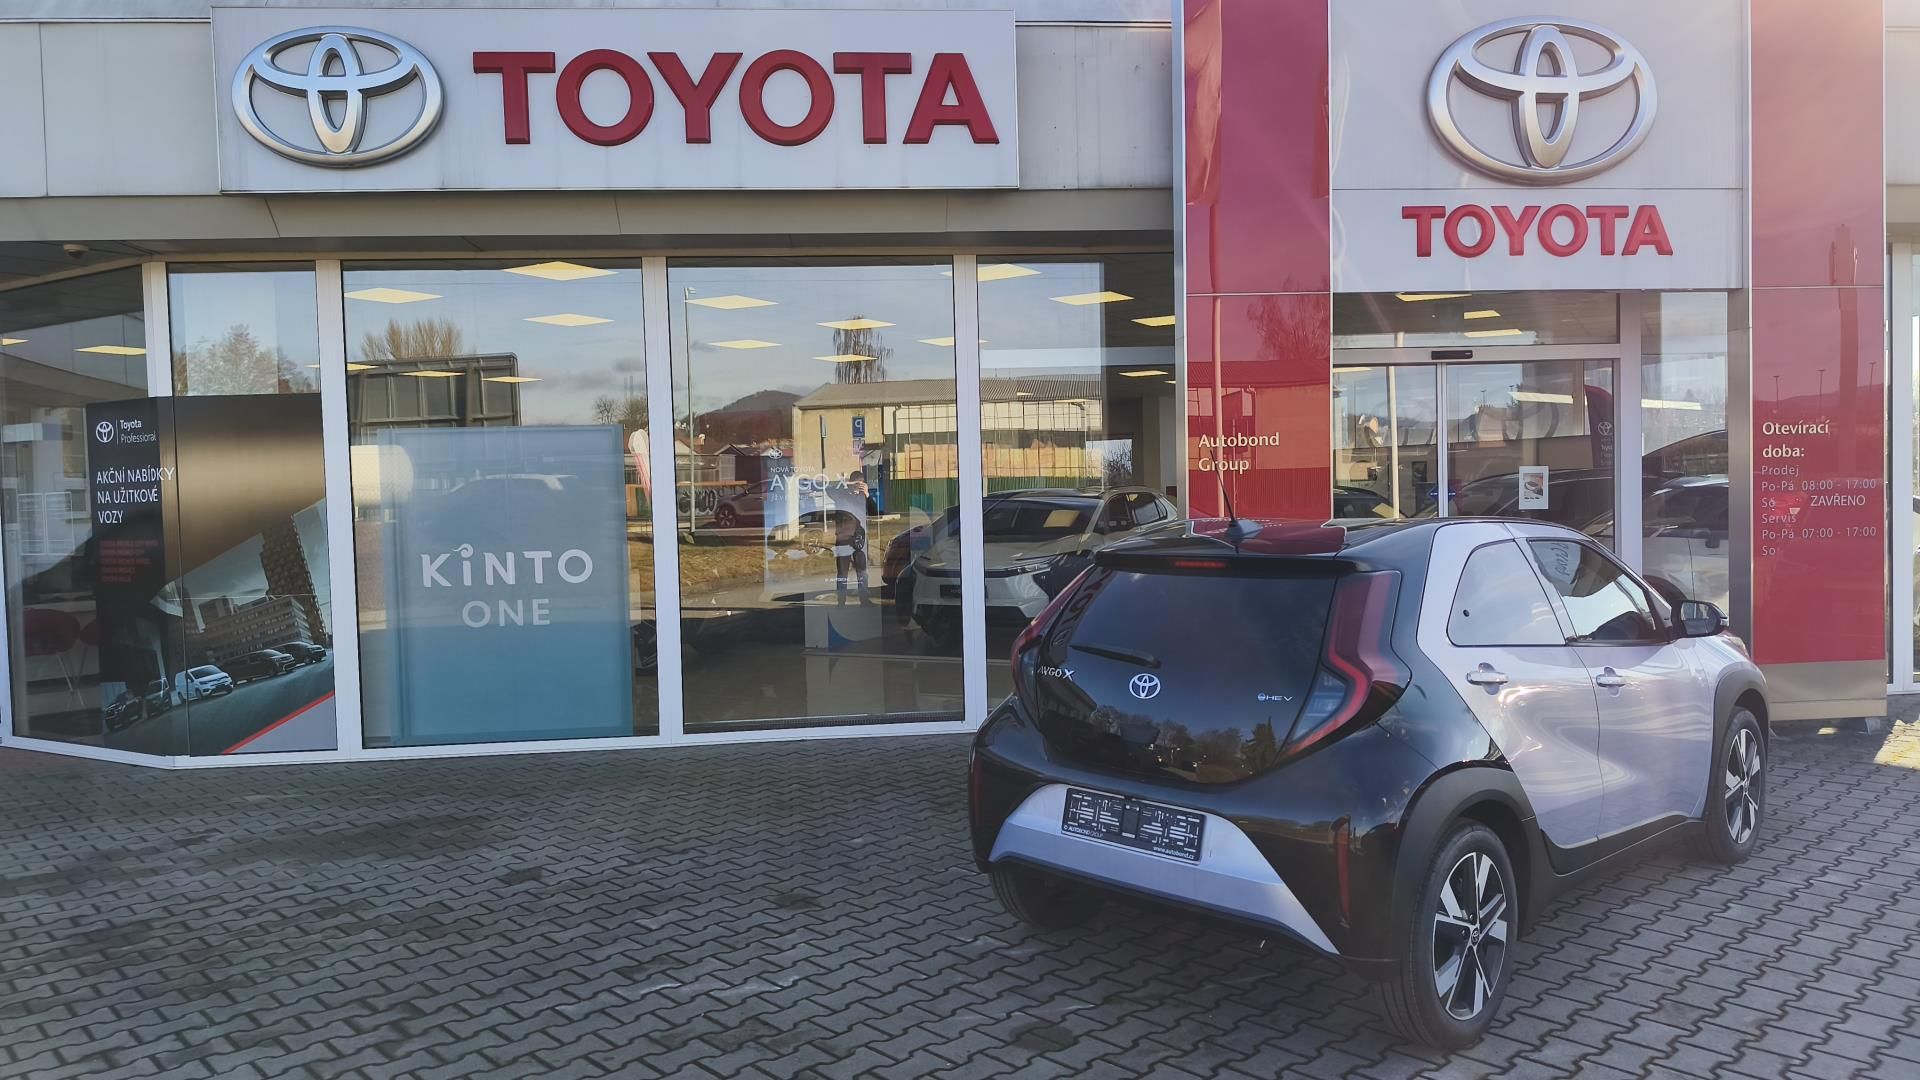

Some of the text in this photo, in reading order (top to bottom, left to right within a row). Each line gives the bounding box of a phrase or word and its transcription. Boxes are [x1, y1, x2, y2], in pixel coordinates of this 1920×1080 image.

[473, 48, 1000, 145] TOYOTA
[1402, 204, 1673, 258] TOYOTA
[120, 419, 142, 431] Toyota
[1762, 421, 1830, 435] Otevírací
[121, 433, 156, 444] Professional
[1198, 432, 1280, 448] Autobond
[1762, 444, 1805, 458] doba:
[1198, 457, 1250, 474] Group
[1761, 465, 1799, 477] Prodej
[97, 465, 175, 484] AKČNÍ NABÍDKY
[770, 474, 829, 491] AYGO
[1761, 480, 1794, 492] Po-Pá
[1801, 479, 1833, 490] 08:00
[1846, 478, 1876, 489] 17:00
[97, 485, 159, 504] NA UŽITKOVÉ
[1810, 493, 1866, 507] ZAVŘENO
[98, 510, 124, 524] VOZY
[1762, 528, 1794, 540] Po-Pá
[1801, 527, 1833, 538] 07:00
[1846, 526, 1876, 537] 17:00
[1762, 546, 1776, 556] So
[462, 598, 551, 628] ONE
[1062, 668, 1075, 681] X
